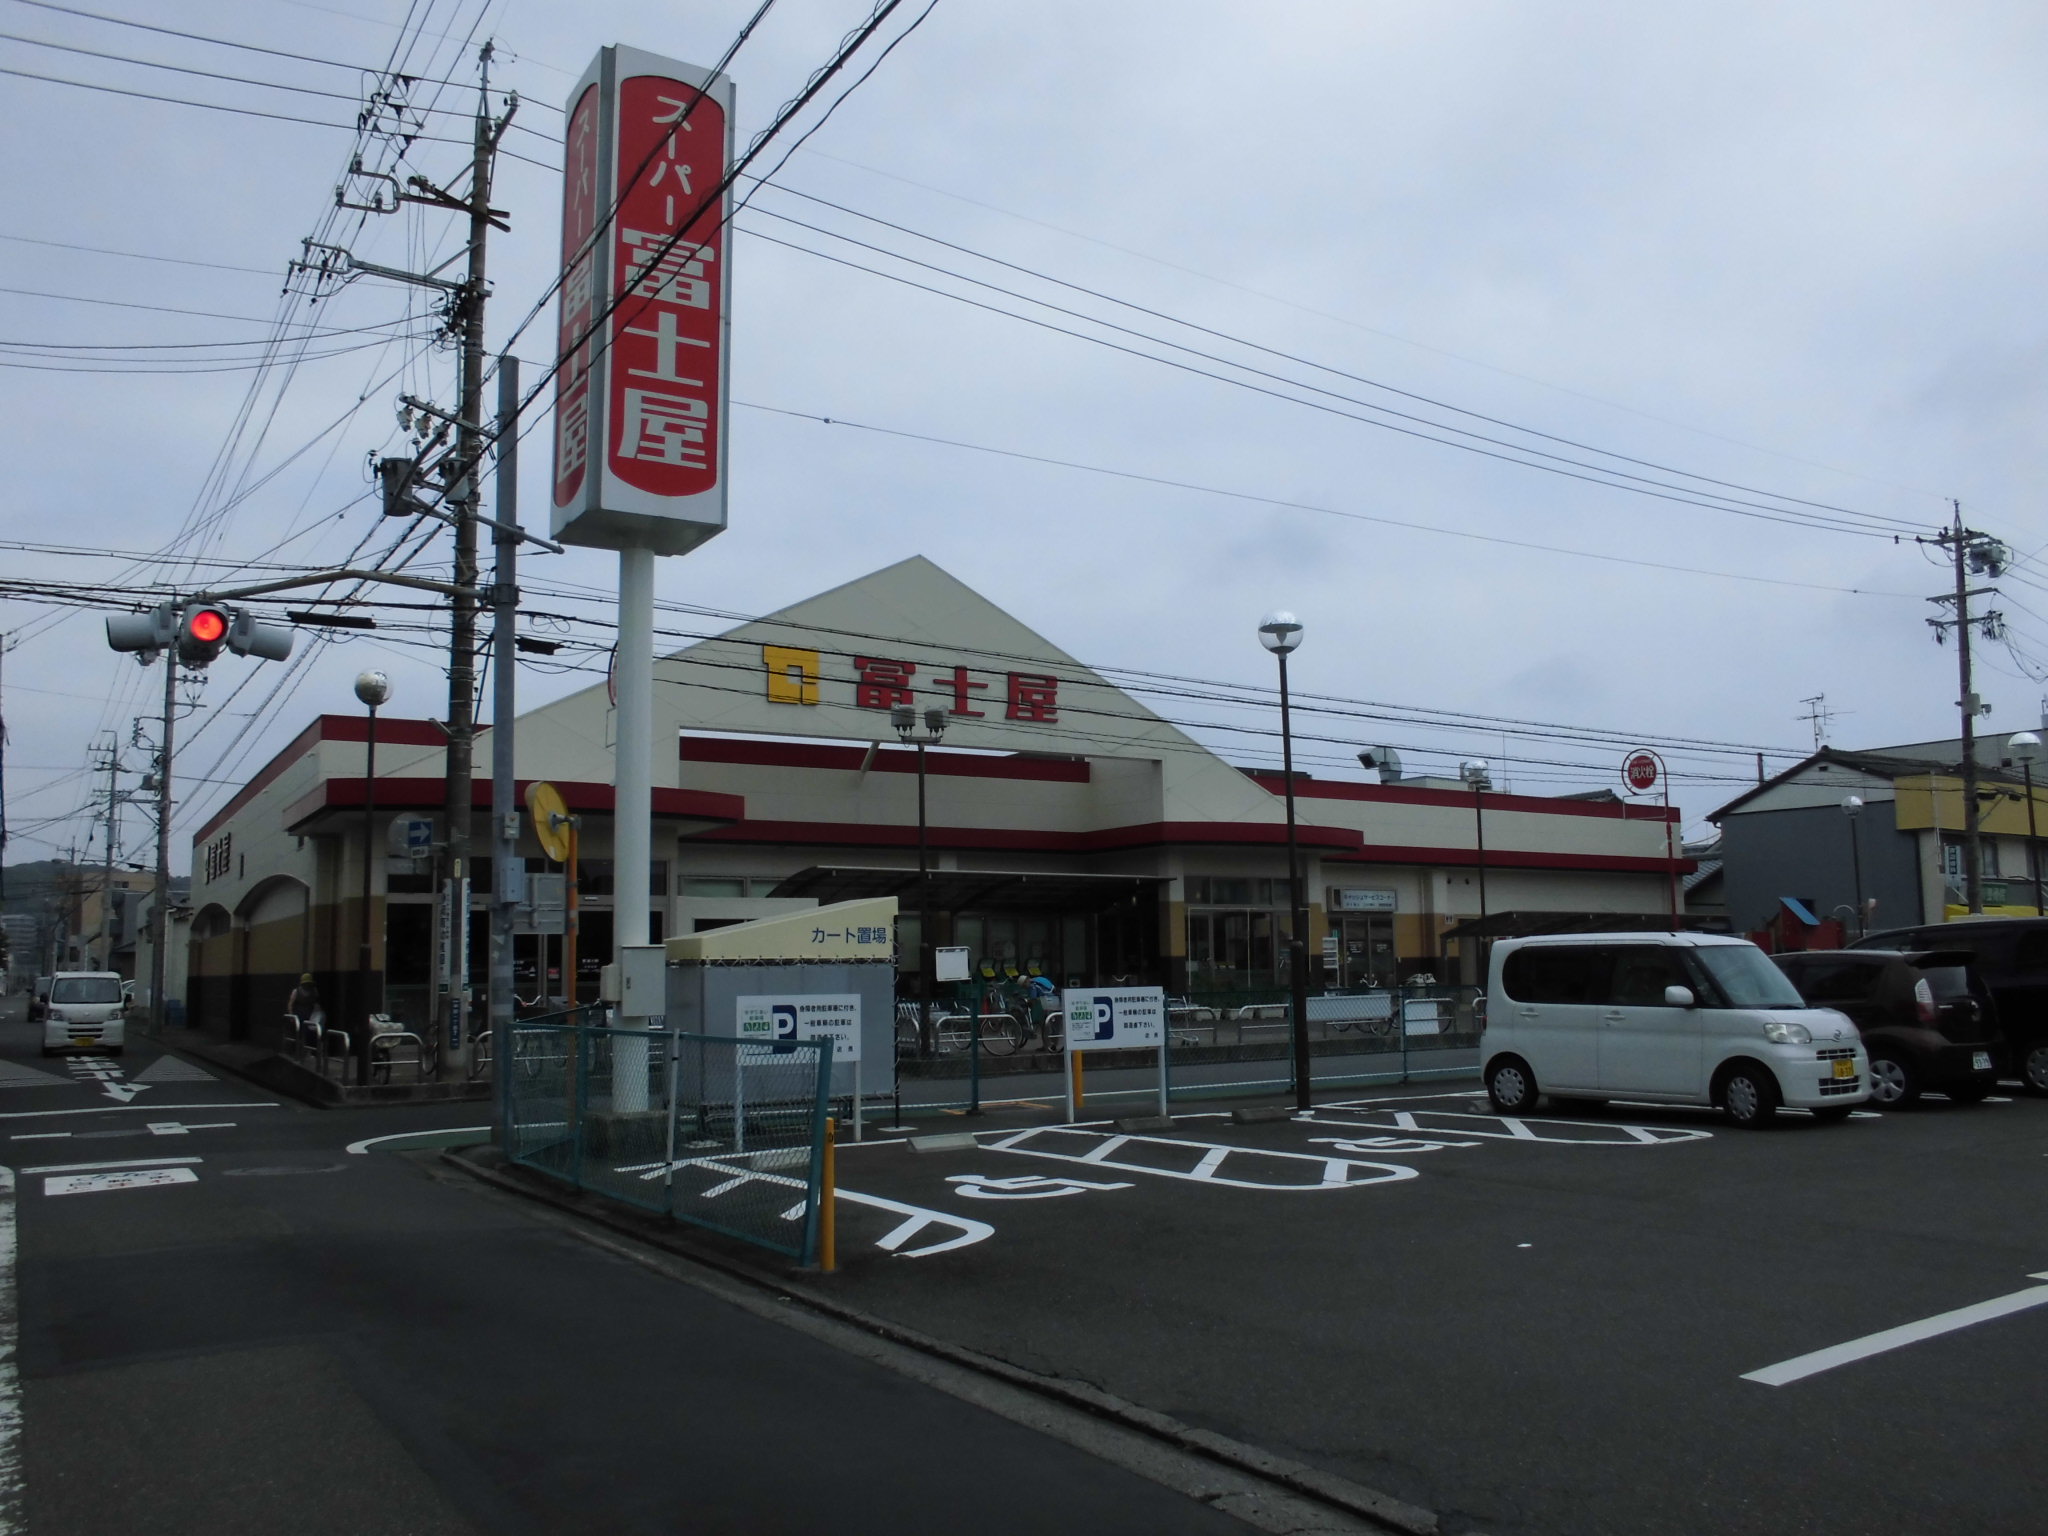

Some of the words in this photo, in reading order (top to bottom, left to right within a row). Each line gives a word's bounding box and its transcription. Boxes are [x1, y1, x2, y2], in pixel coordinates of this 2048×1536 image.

[649, 94, 693, 227] スーパー
[811, 927, 887, 944] カート置場
